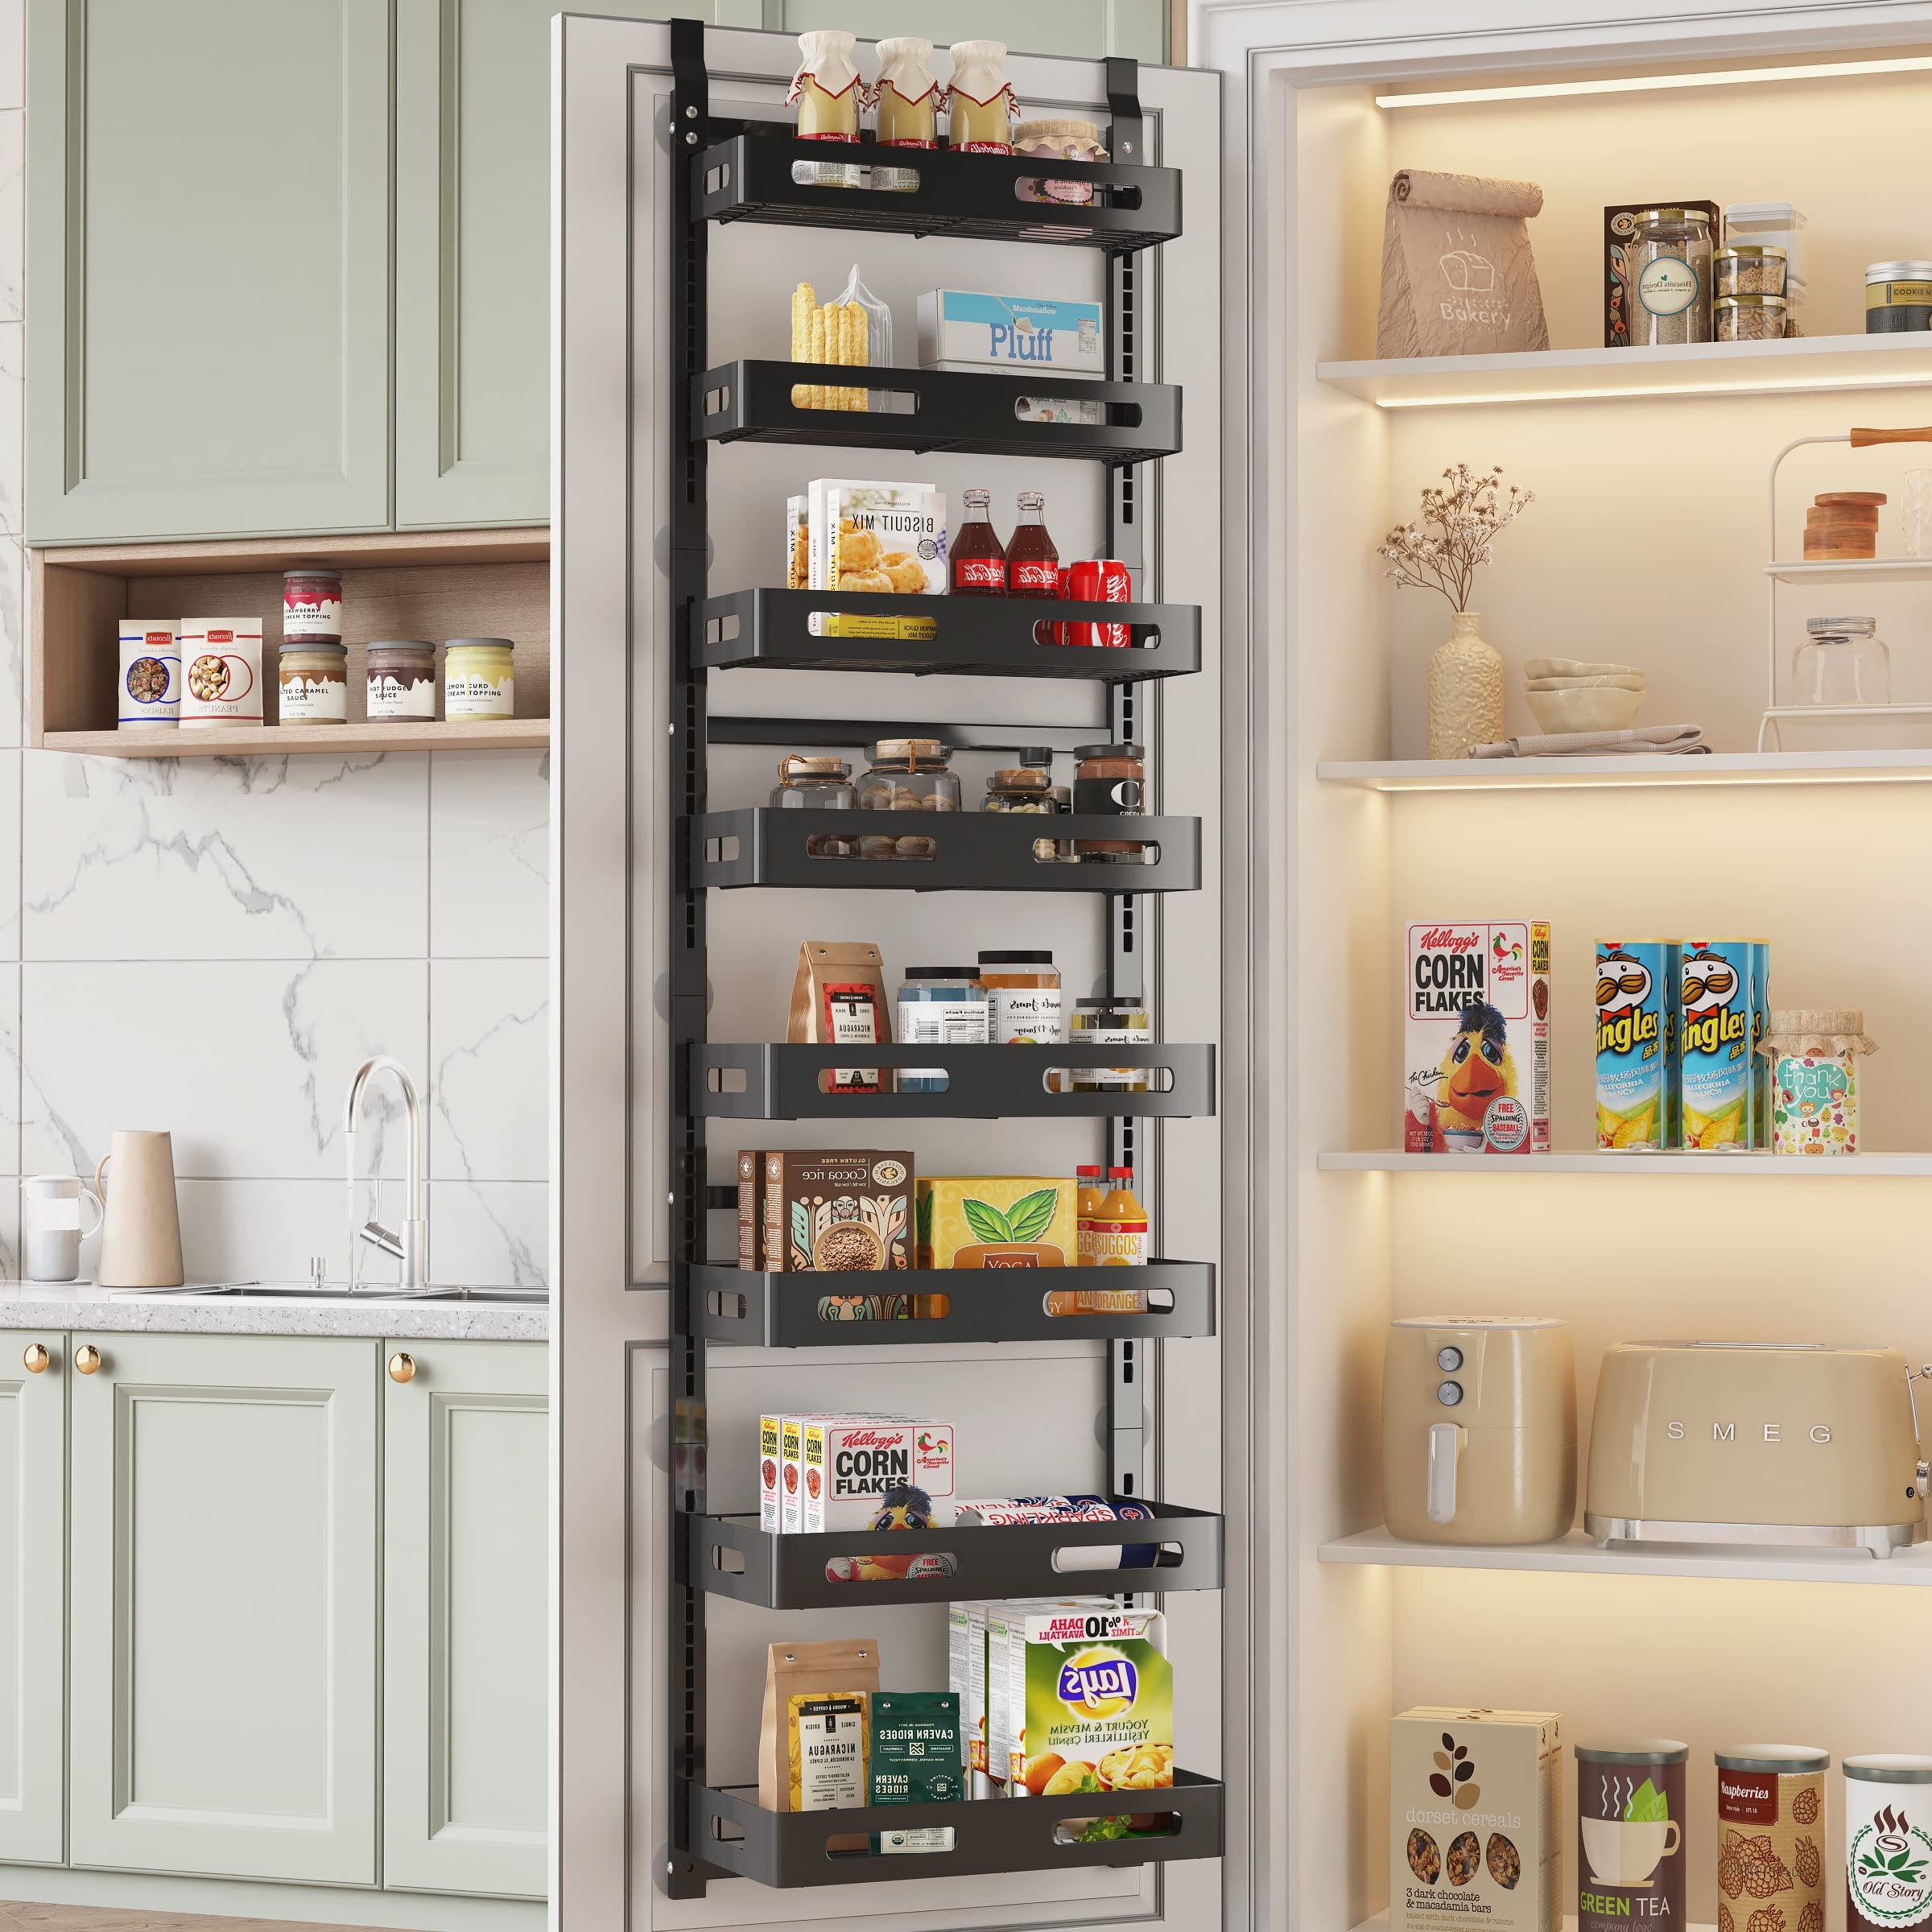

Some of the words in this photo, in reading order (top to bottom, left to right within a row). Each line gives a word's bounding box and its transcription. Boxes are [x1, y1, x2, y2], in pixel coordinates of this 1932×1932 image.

[1441, 298, 1510, 330] Bakery
[990, 323, 1053, 361] Pluff
[1421, 927, 1480, 954] Kellogg's
[1533, 939, 1548, 959] CORN
[1415, 954, 1484, 989] CORN
[1492, 964, 1521, 974] America's
[1533, 960, 1548, 972] FLAKES
[1415, 991, 1484, 1012] FLAKES
[1596, 1008, 1659, 1053] ingles
[1682, 1008, 1746, 1053] ingles
[1409, 1071, 1418, 1084] The
[1418, 1067, 1449, 1087] Chicken
[1784, 1063, 1842, 1088] thank
[1786, 1085, 1827, 1108] you
[1498, 1103, 1514, 1113] FREE
[1491, 1113, 1521, 1123] SPALDING
[1493, 1123, 1520, 1133] BASEBALL
[1098, 1234, 1137, 1255] SUGGOS
[1098, 1293, 1137, 1309] ORANGE
[762, 1430, 777, 1447] CORN
[841, 1430, 904, 1450] Kellogg's
[1667, 1421, 1831, 1443] SMEG
[762, 1445, 778, 1455] FLAKES
[784, 1435, 799, 1451] CORN
[807, 1439, 822, 1455] CORN
[784, 1449, 799, 1459] FLAKES
[807, 1454, 822, 1464] FLAKES
[836, 1449, 908, 1478] CORN
[917, 1456, 947, 1464] America's
[836, 1476, 908, 1495] FLAKES
[923, 1558, 939, 1566] FREE
[1721, 1780, 1769, 1799] Raspberries
[1406, 1806, 1458, 1826] dorset
[1462, 1812, 1521, 1829] cereals
[1406, 1888, 1413, 1897] 3
[1414, 1889, 1436, 1899] dark
[1437, 1890, 1480, 1901] chocolate
[1863, 1880, 1889, 1895] Old
[1887, 1884, 1924, 1901] Story
[1406, 1898, 1415, 1909] &
[1416, 1901, 1470, 1912] macadamia
[1472, 1903, 1492, 1913] bars
[1581, 1891, 1630, 1916] GREEN
[1636, 1896, 1670, 1917] TEA
[1406, 1912, 1425, 1920] baked
[1441, 1913, 1455, 1922] dark
[1456, 1914, 1485, 1923] chocolate
[1591, 1919, 1629, 1932] company
[1633, 1920, 1653, 1932] logo
